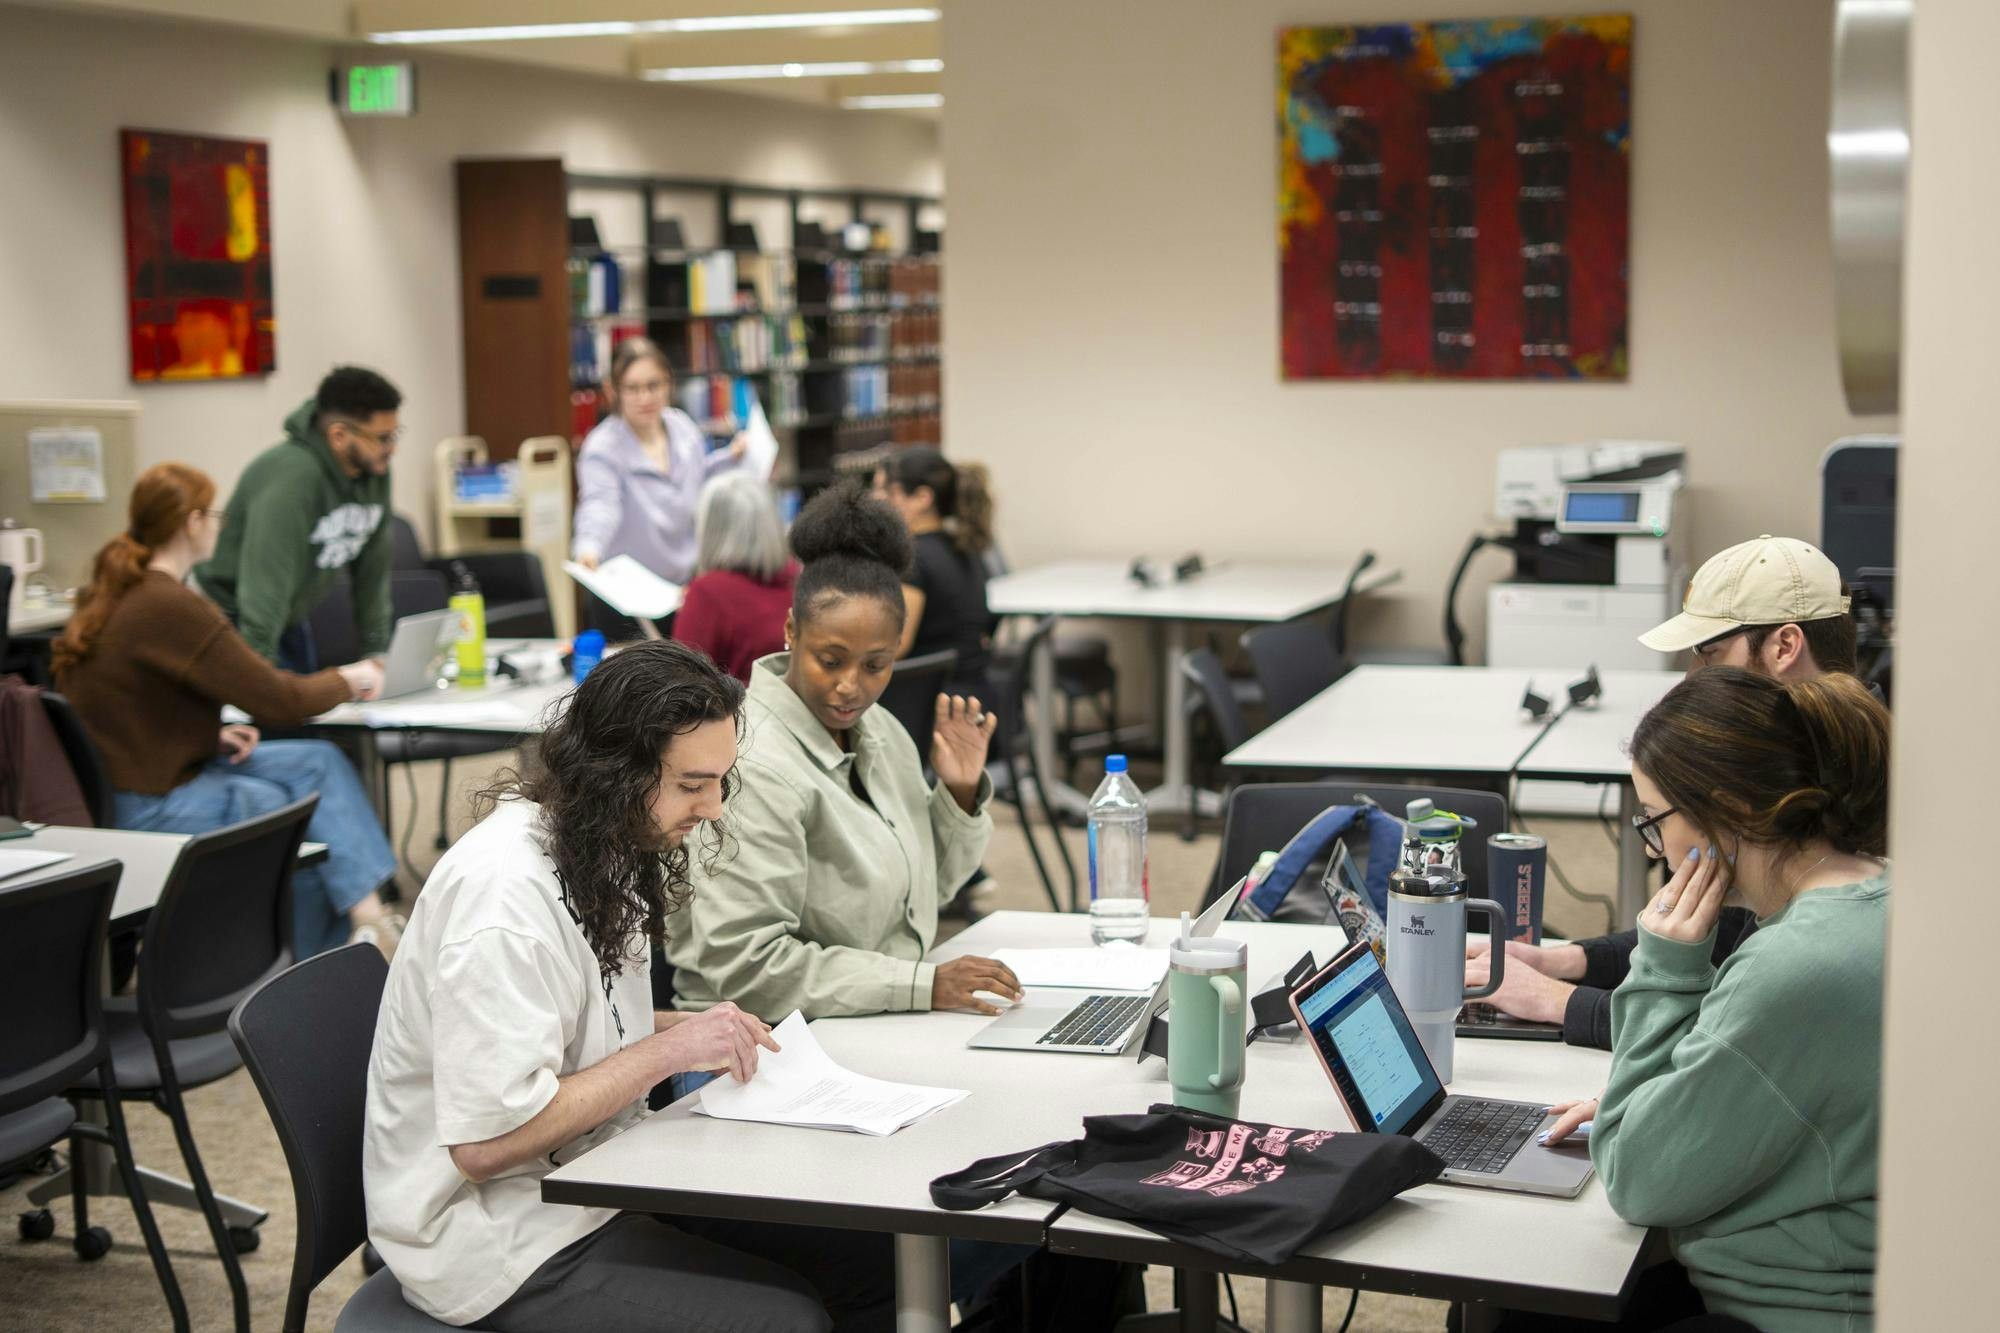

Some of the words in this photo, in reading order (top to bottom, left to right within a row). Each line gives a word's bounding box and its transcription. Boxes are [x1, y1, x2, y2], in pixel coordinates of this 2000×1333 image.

[349, 65, 398, 113] EXIT
[1516, 863, 1532, 927] REBELS
[1400, 926, 1436, 936] STANLEY
